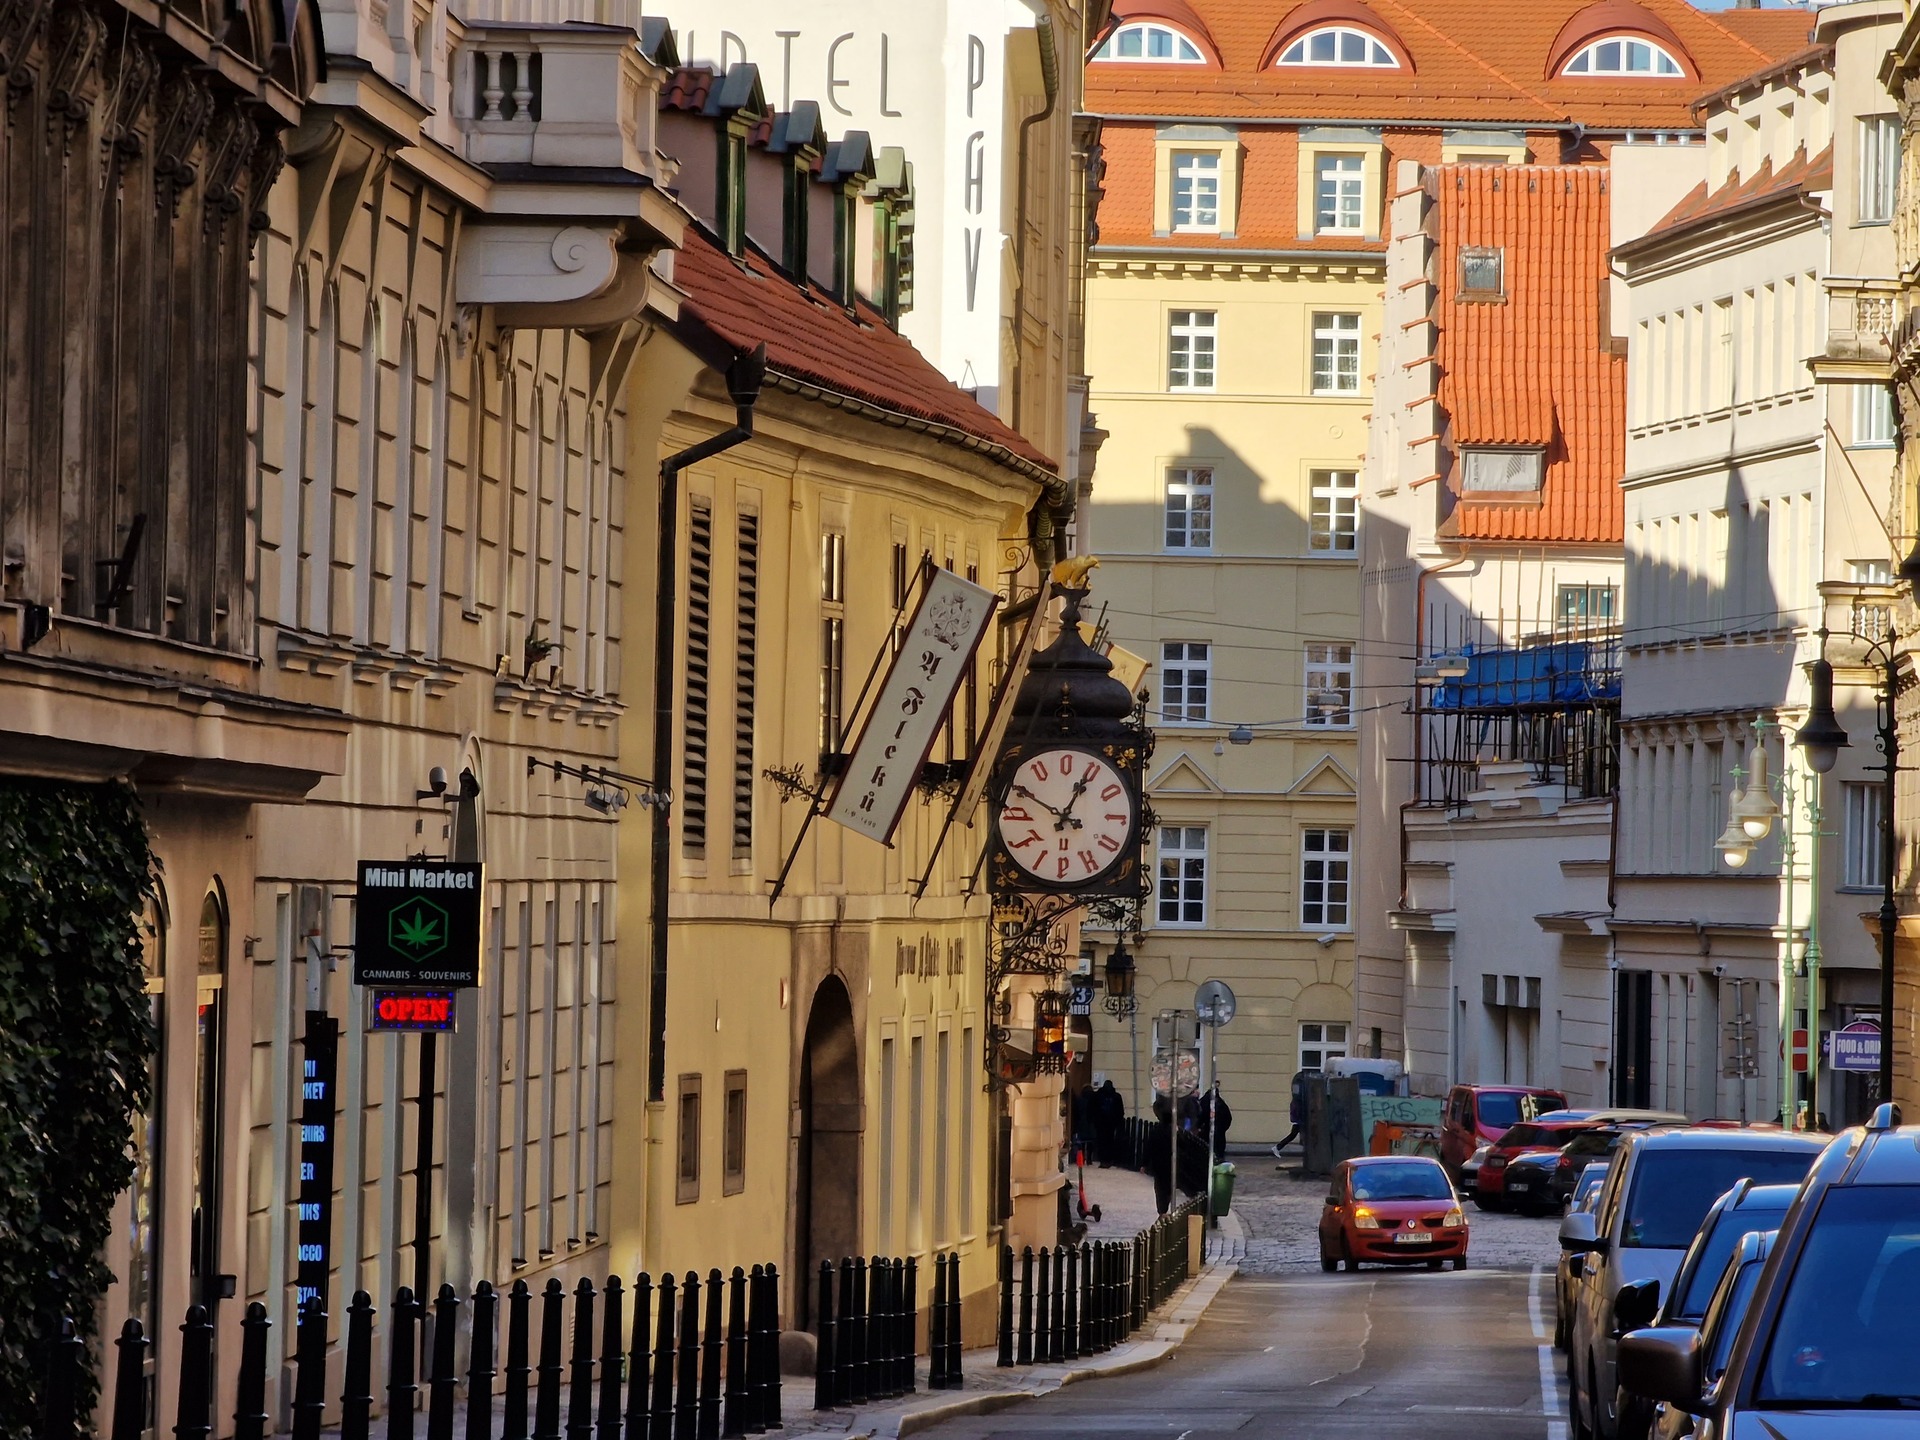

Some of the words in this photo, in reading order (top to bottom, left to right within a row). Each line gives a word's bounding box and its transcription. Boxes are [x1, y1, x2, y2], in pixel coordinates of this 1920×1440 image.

[365, 867, 405, 888] Mini
[409, 868, 474, 889] Market
[362, 969, 410, 979] CANNABIS
[419, 970, 472, 981] SOUVENIRS
[379, 997, 449, 1021] OPEN
[1837, 1039, 1857, 1053] FOOD
[1857, 1041, 1864, 1054] &
